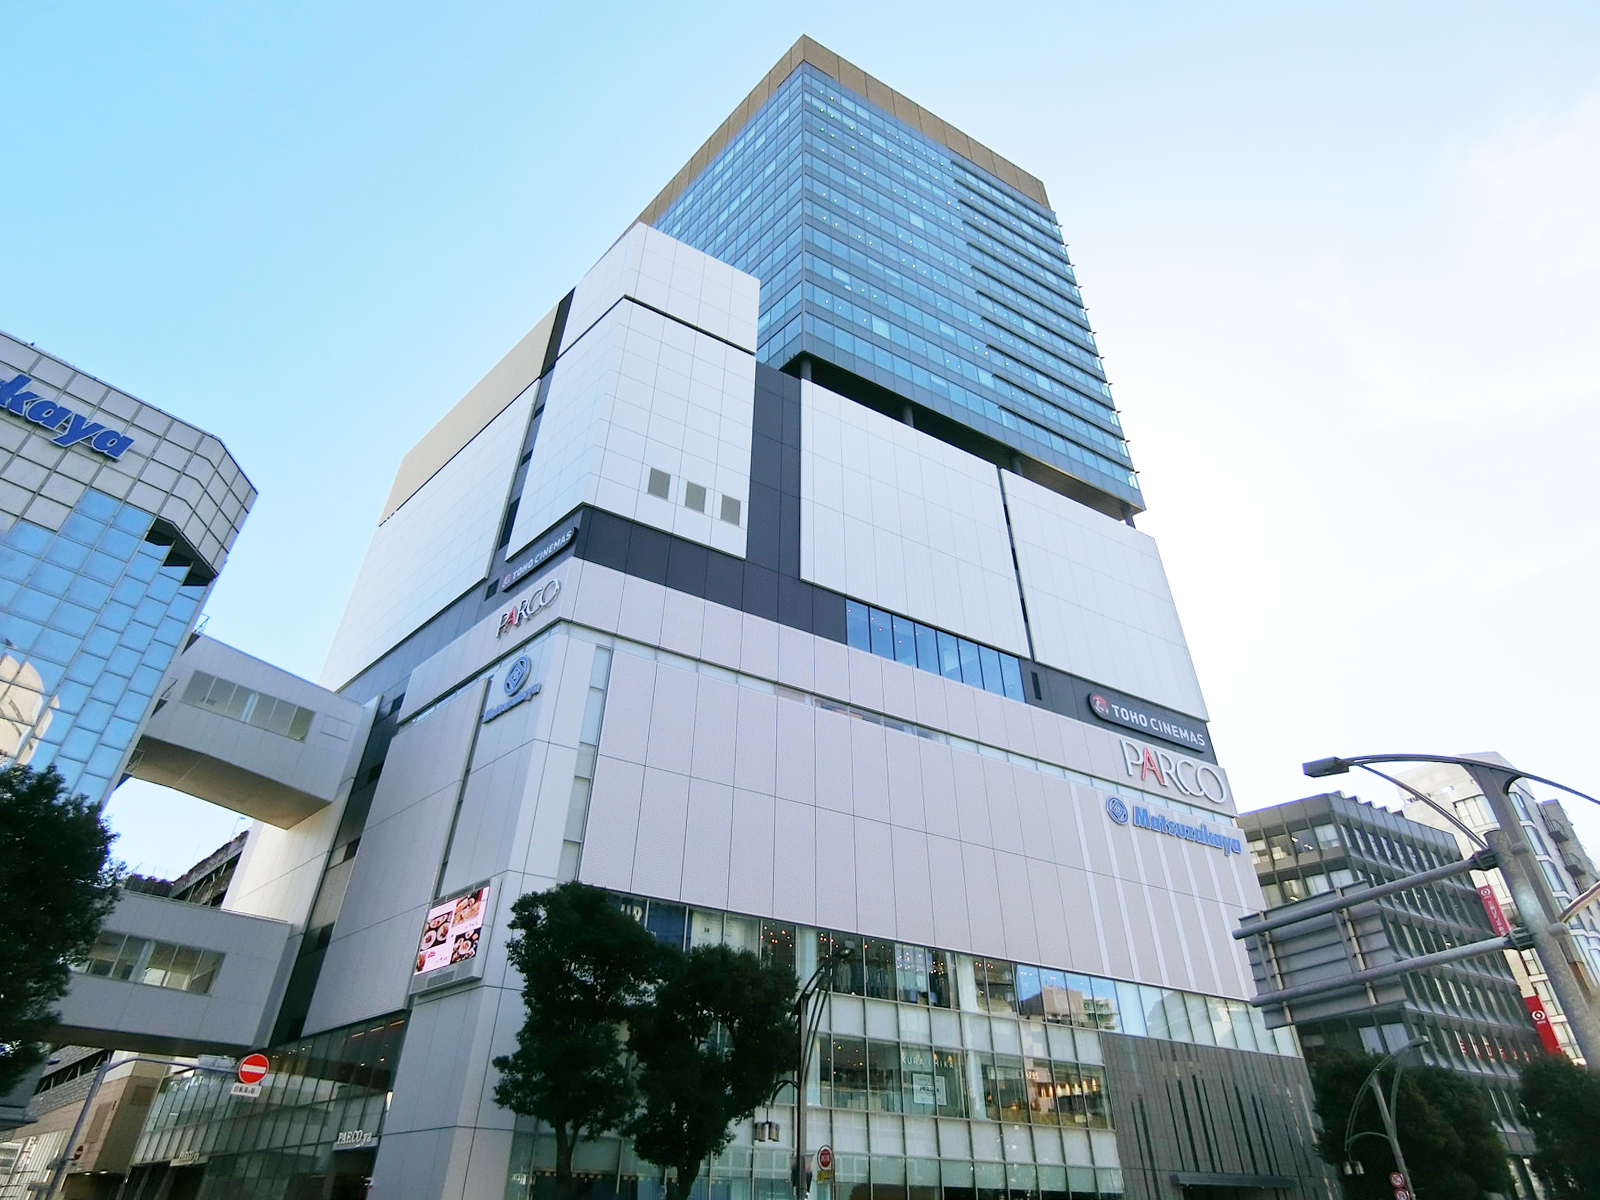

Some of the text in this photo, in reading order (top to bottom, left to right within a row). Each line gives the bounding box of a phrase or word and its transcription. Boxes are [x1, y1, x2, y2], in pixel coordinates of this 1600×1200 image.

[512, 530, 573, 580] TOHO CINEMAS
[496, 578, 561, 638] PARCO
[1111, 704, 1206, 747] TOHO CINEMAS
[1119, 738, 1227, 804] PARCO
[1132, 804, 1242, 857] Matsuzakaya
